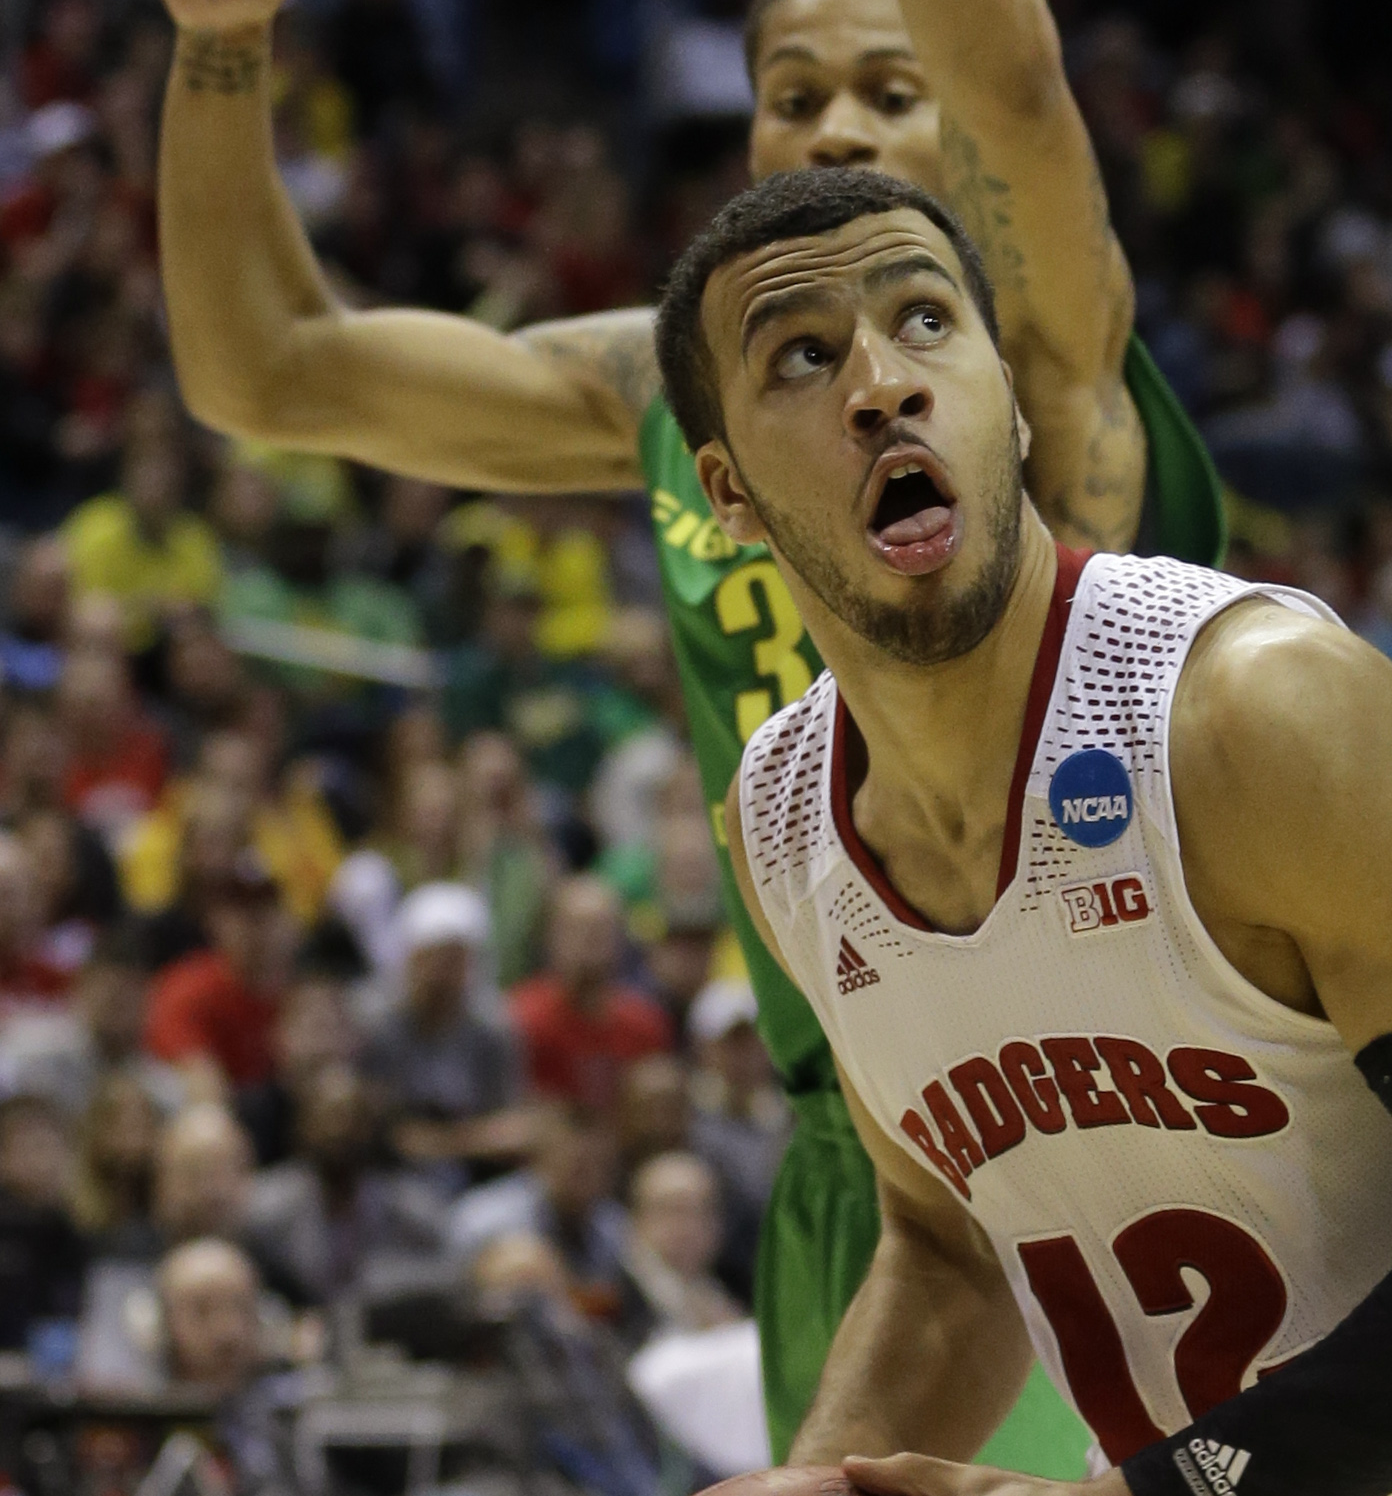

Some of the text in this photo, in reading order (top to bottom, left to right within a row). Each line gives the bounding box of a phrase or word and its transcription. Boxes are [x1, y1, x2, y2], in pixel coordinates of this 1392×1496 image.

[1061, 794, 1129, 824] NCAA
[900, 1035, 1290, 1202] BADGERS
[1017, 1207, 1289, 1467] 12
